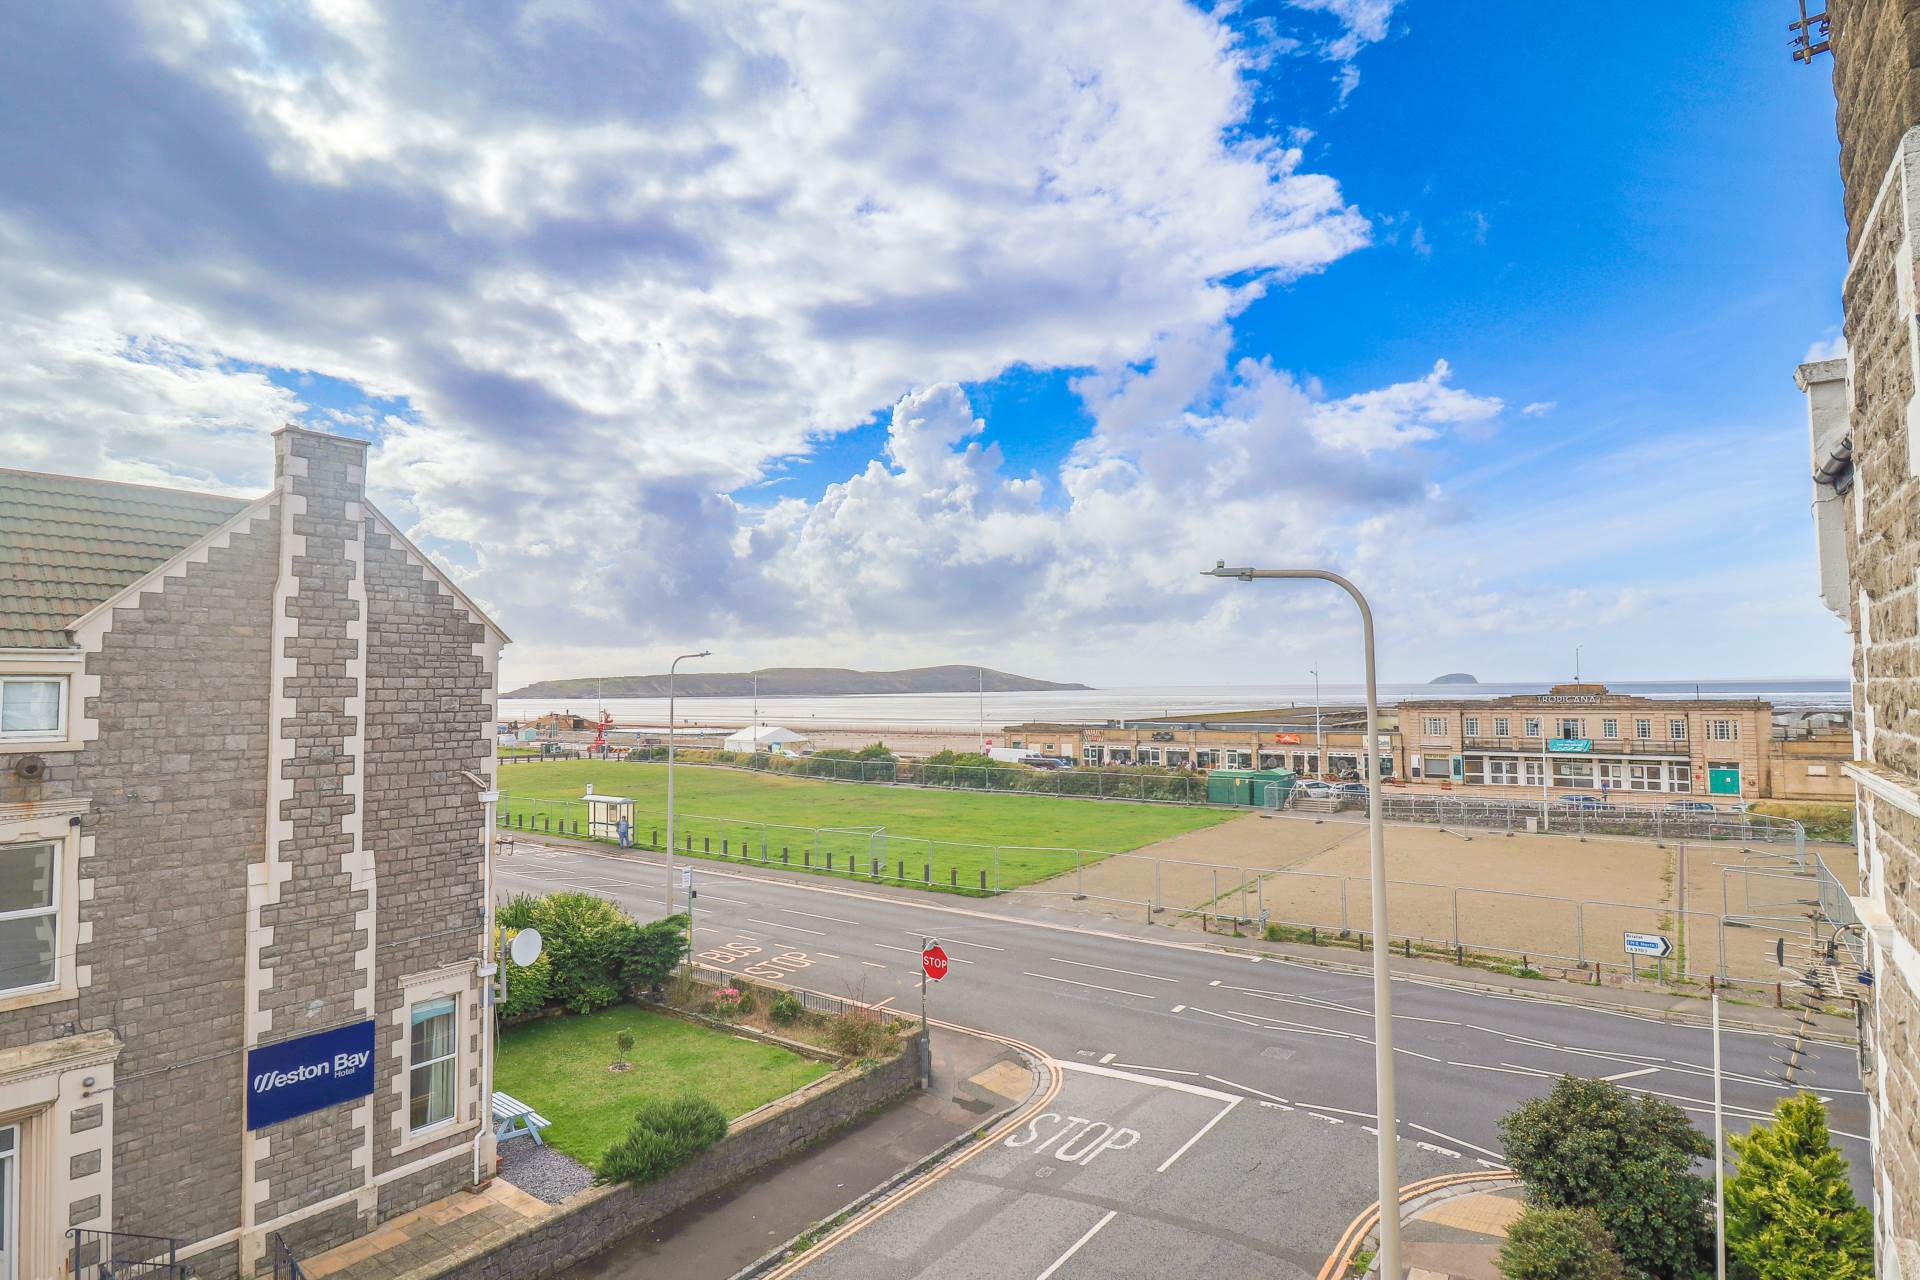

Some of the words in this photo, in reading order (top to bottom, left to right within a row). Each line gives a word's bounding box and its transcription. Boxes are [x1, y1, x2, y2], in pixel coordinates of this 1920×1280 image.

[1537, 695, 1597, 704] TROPICANA
[696, 942, 762, 964] BUS
[923, 955, 948, 969] STOP
[744, 951, 817, 979] STOP
[334, 1050, 370, 1071] Bay
[334, 1066, 356, 1078] Hotel
[1004, 1113, 1141, 1166] STOP
